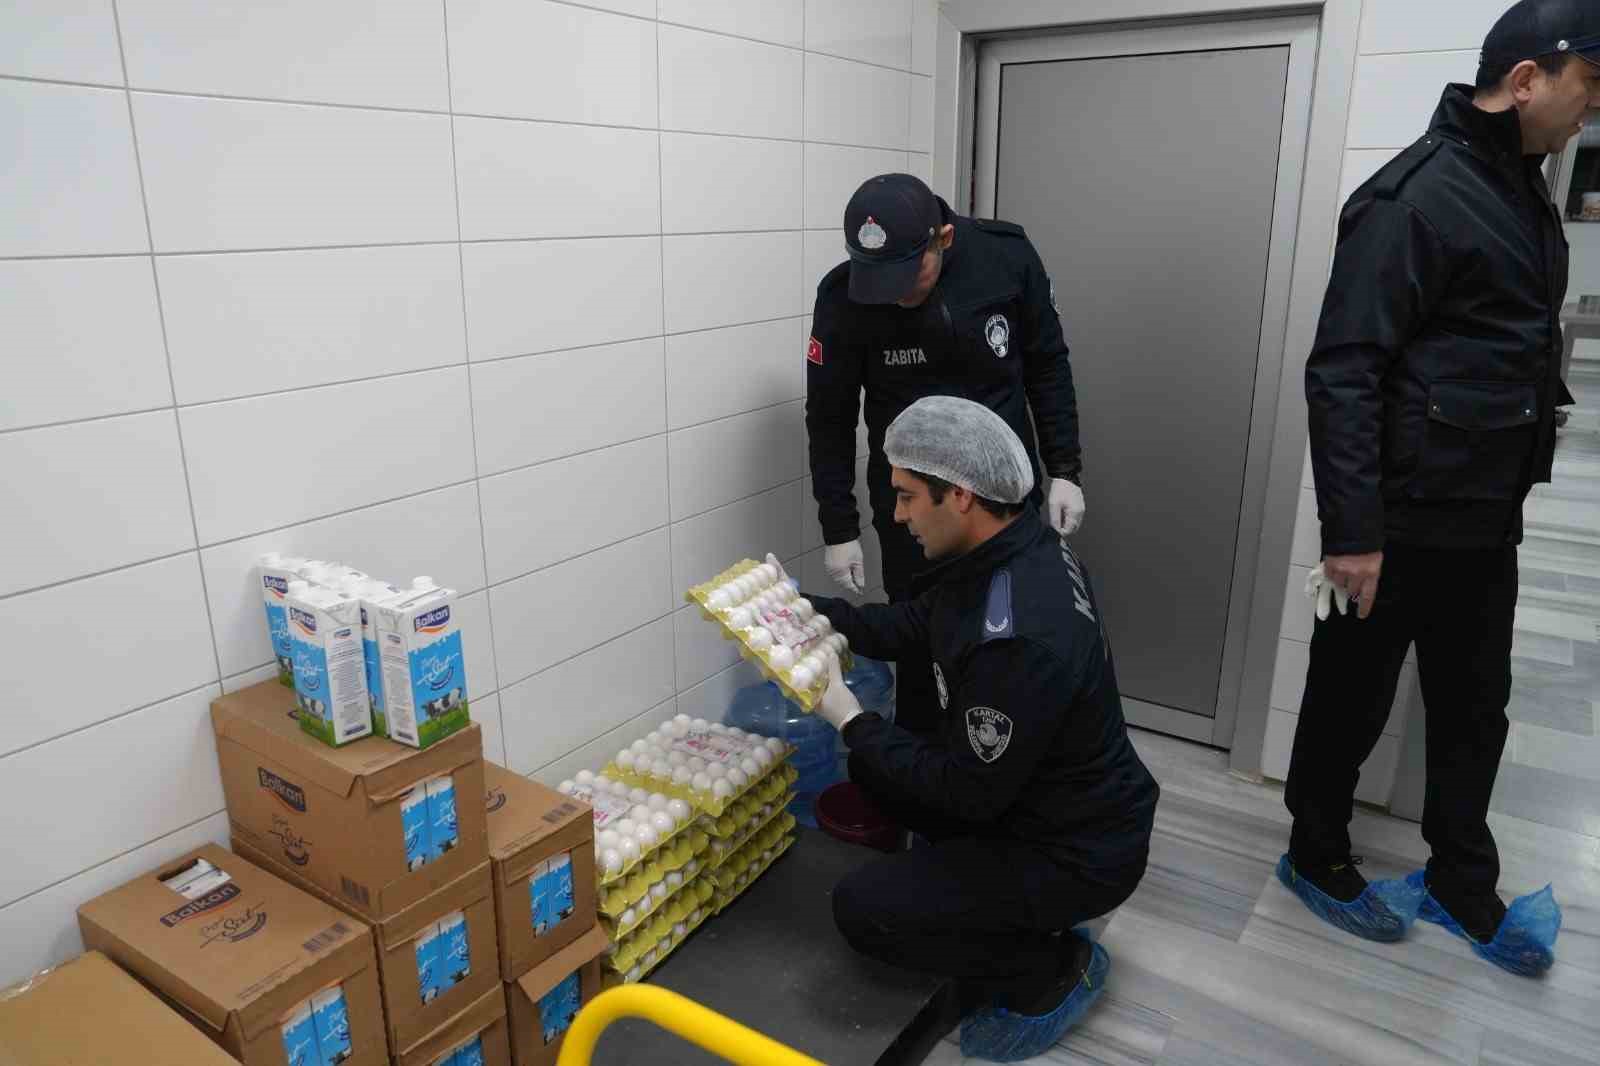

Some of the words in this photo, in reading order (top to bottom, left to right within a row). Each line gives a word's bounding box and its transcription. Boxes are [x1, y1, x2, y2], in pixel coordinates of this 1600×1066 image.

[883, 348, 927, 366] ZABITA
[415, 608, 449, 628] Balkan
[261, 771, 304, 805] Balkan
[166, 887, 236, 924] Balkan
